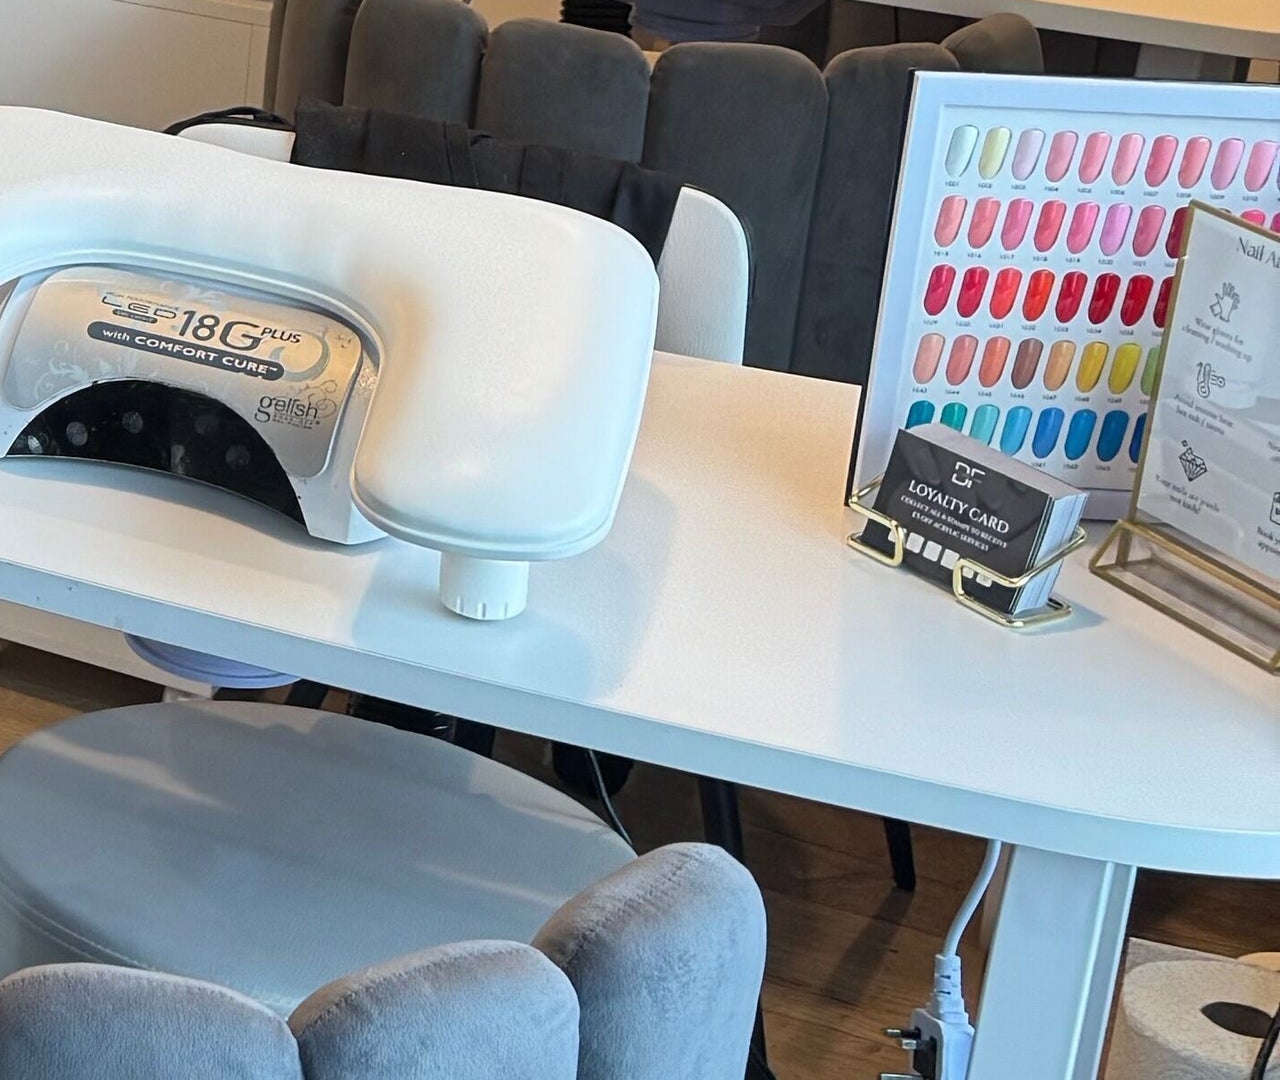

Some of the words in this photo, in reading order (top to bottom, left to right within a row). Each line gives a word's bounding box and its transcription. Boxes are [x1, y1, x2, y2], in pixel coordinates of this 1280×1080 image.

[1236, 236, 1265, 262] Nail
[101, 295, 177, 320] LED
[178, 310, 262, 351] 18G
[260, 326, 302, 344] PLUS
[101, 329, 131, 342] with
[134, 335, 219, 362] COMFORT
[254, 395, 318, 423] gelish
[908, 479, 969, 515] LOYALTY
[968, 507, 1010, 534] CARD
